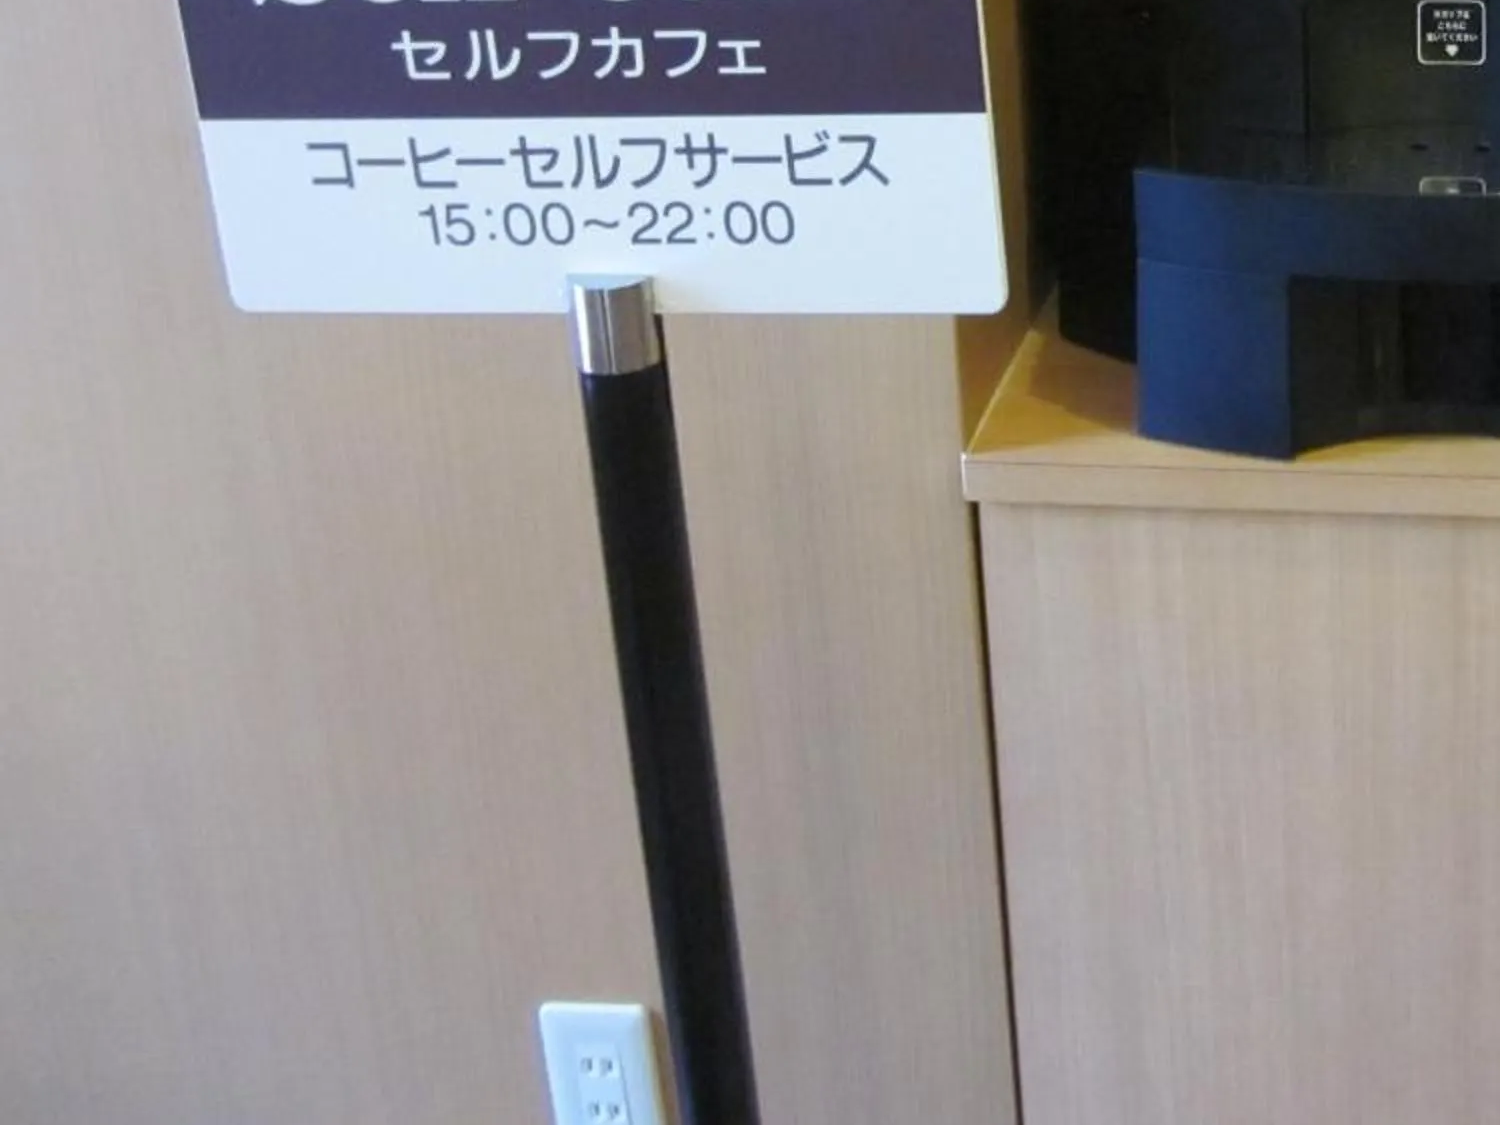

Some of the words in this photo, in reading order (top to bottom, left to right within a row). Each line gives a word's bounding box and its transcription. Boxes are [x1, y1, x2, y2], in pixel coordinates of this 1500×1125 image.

[390, 26, 768, 82] セルフカフェ
[305, 131, 891, 191] コーヒーセルフサービス
